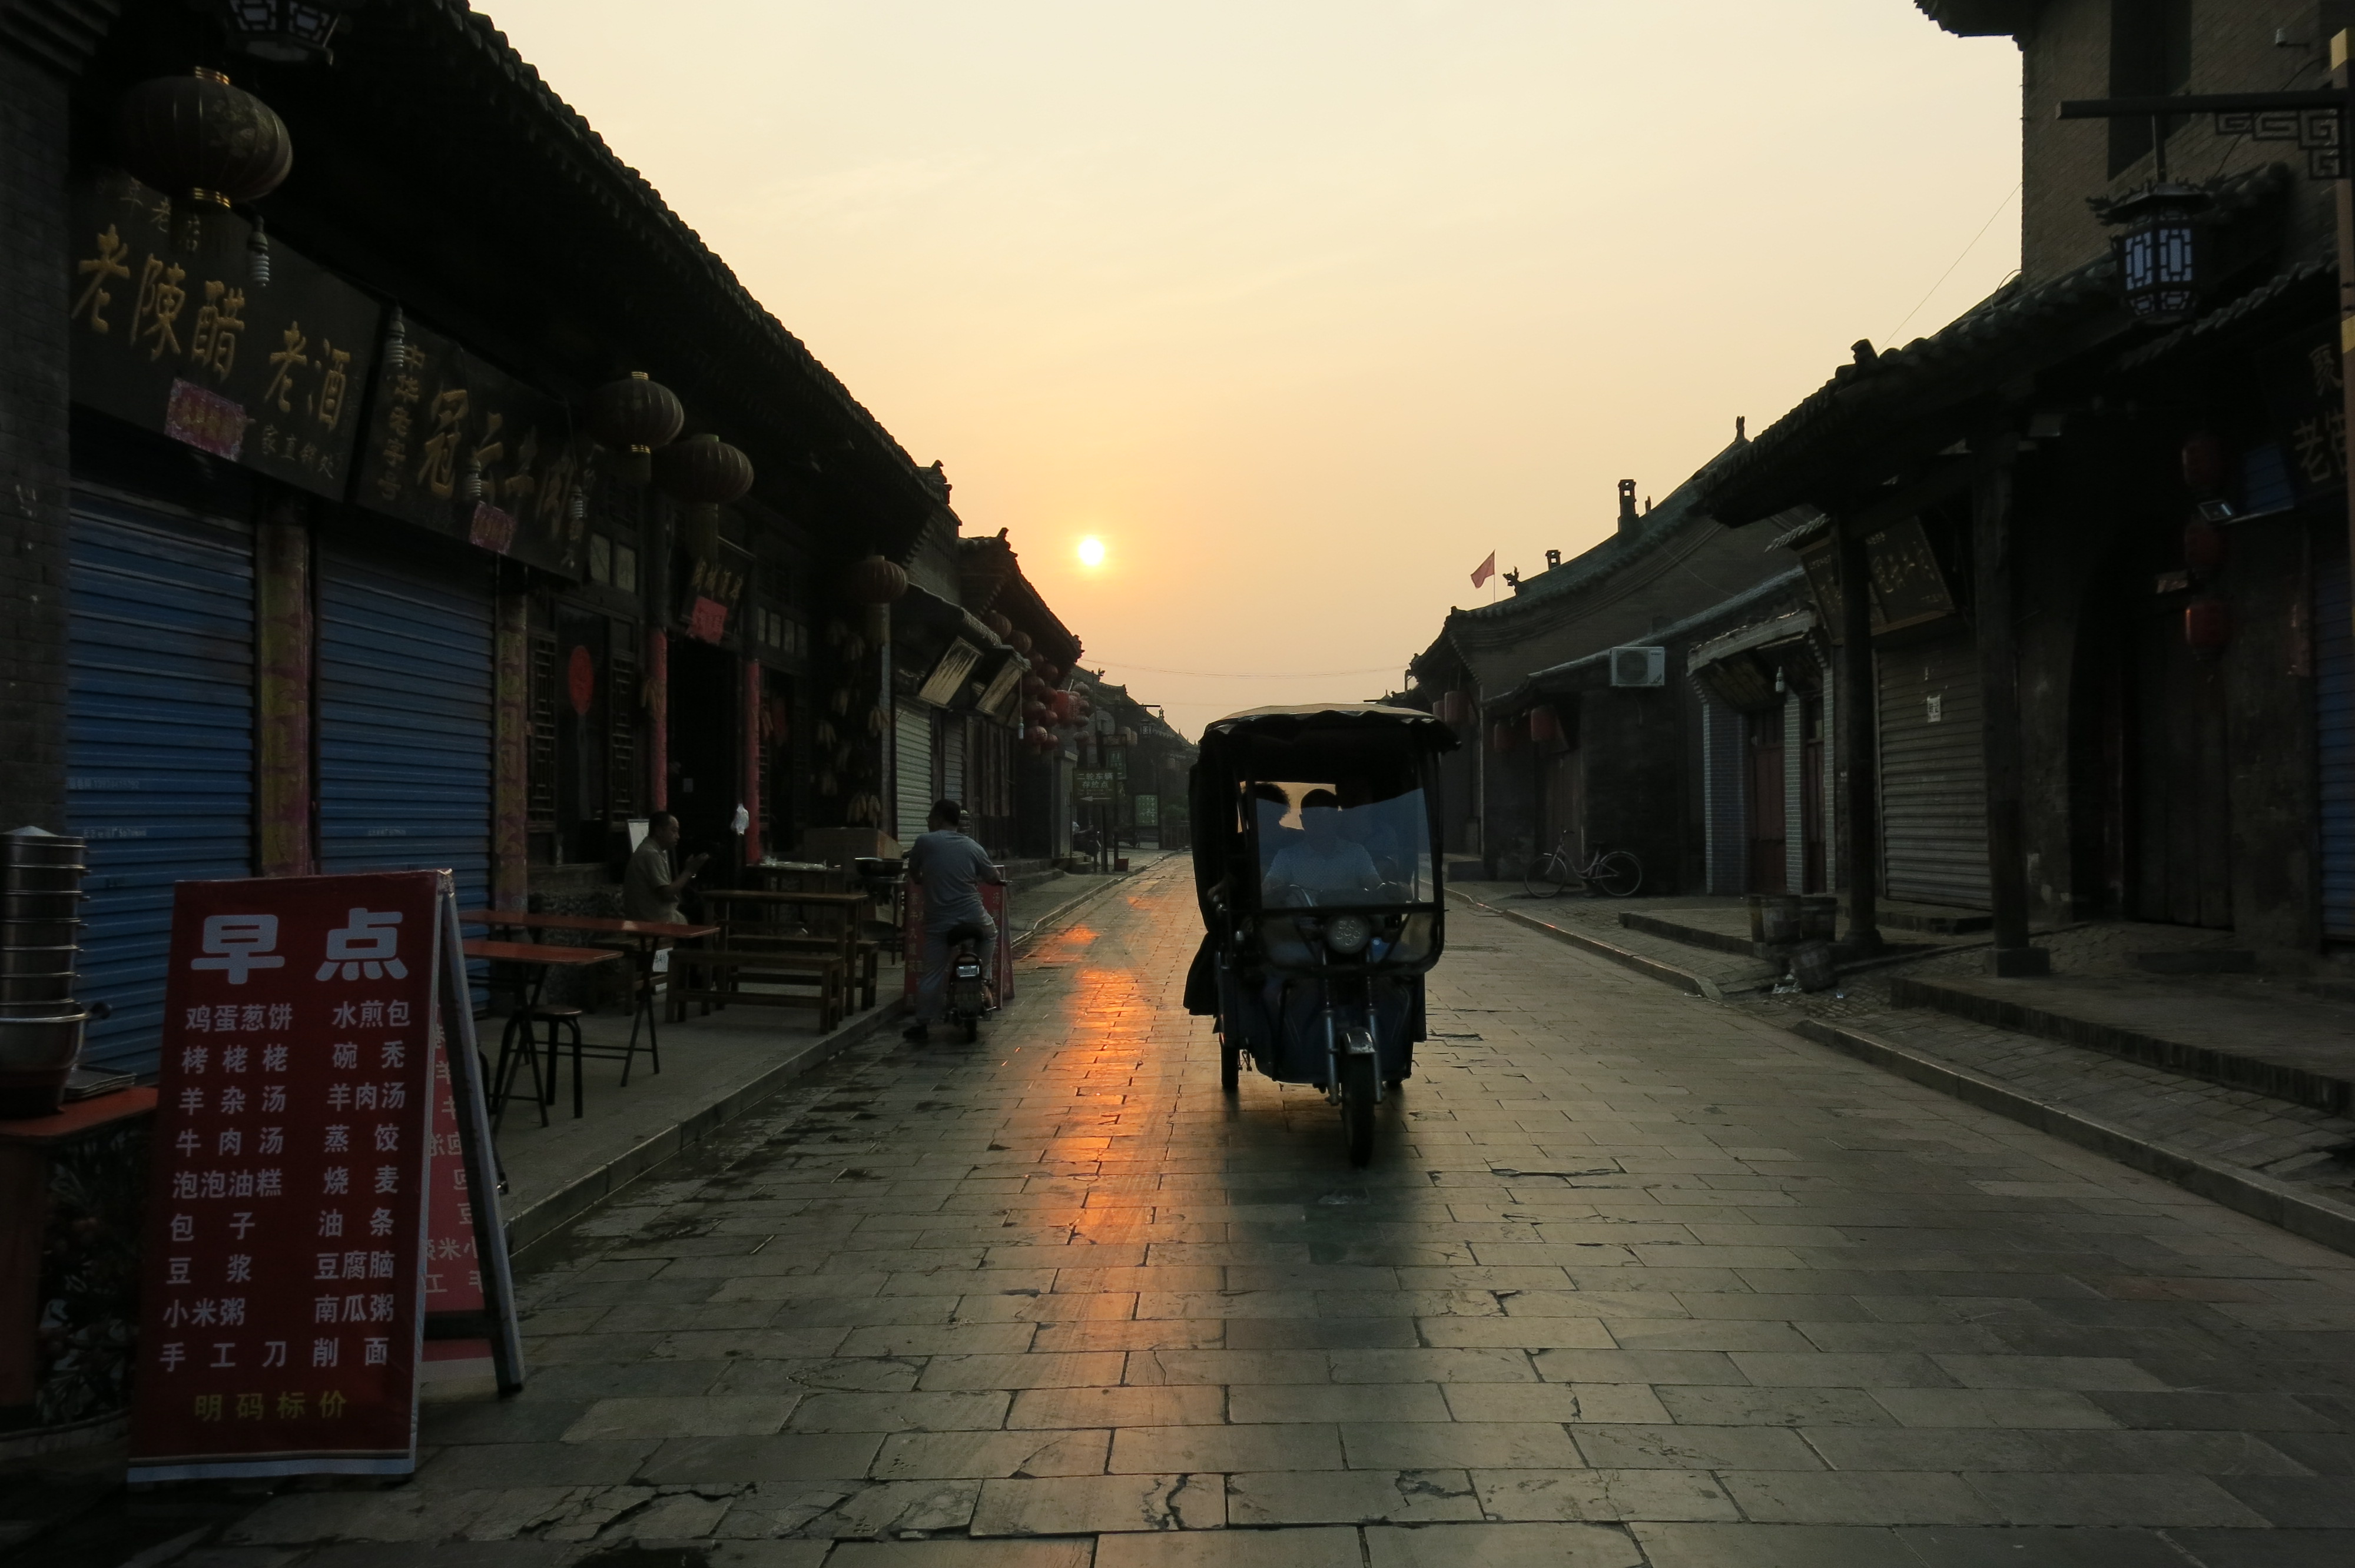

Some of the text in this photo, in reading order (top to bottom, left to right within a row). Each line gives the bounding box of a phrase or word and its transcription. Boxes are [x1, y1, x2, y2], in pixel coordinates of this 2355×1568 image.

[71, 222, 246, 384] 老陳醋
[264, 320, 351, 433] 老酒
[1077, 772, 1113, 780] 二轮车辆
[191, 908, 408, 985] 早点
[185, 1003, 293, 1032] 鸡蛋葱饼
[332, 999, 410, 1029] 水煎包
[182, 1044, 288, 1074] 栲栳栳
[332, 1041, 404, 1069] 碗秃
[180, 1085, 286, 1115] 羊杂汤
[327, 1082, 405, 1111] 羊肉汤
[176, 1127, 283, 1157] 牛肉汤
[324, 1123, 399, 1152] 蒸饺
[173, 1168, 282, 1199] 泡泡油糕
[323, 1165, 399, 1194] 烧麦
[170, 1212, 255, 1241] 包子
[319, 1207, 394, 1237] 油条
[167, 1254, 251, 1284] 豆浆
[314, 1250, 394, 1279] 豆腐脑
[164, 1297, 245, 1328] 小米粥
[315, 1294, 393, 1323] 南瓜粥
[160, 1337, 389, 1371] 手工刀削面
[195, 1390, 347, 1421] 明码标价
